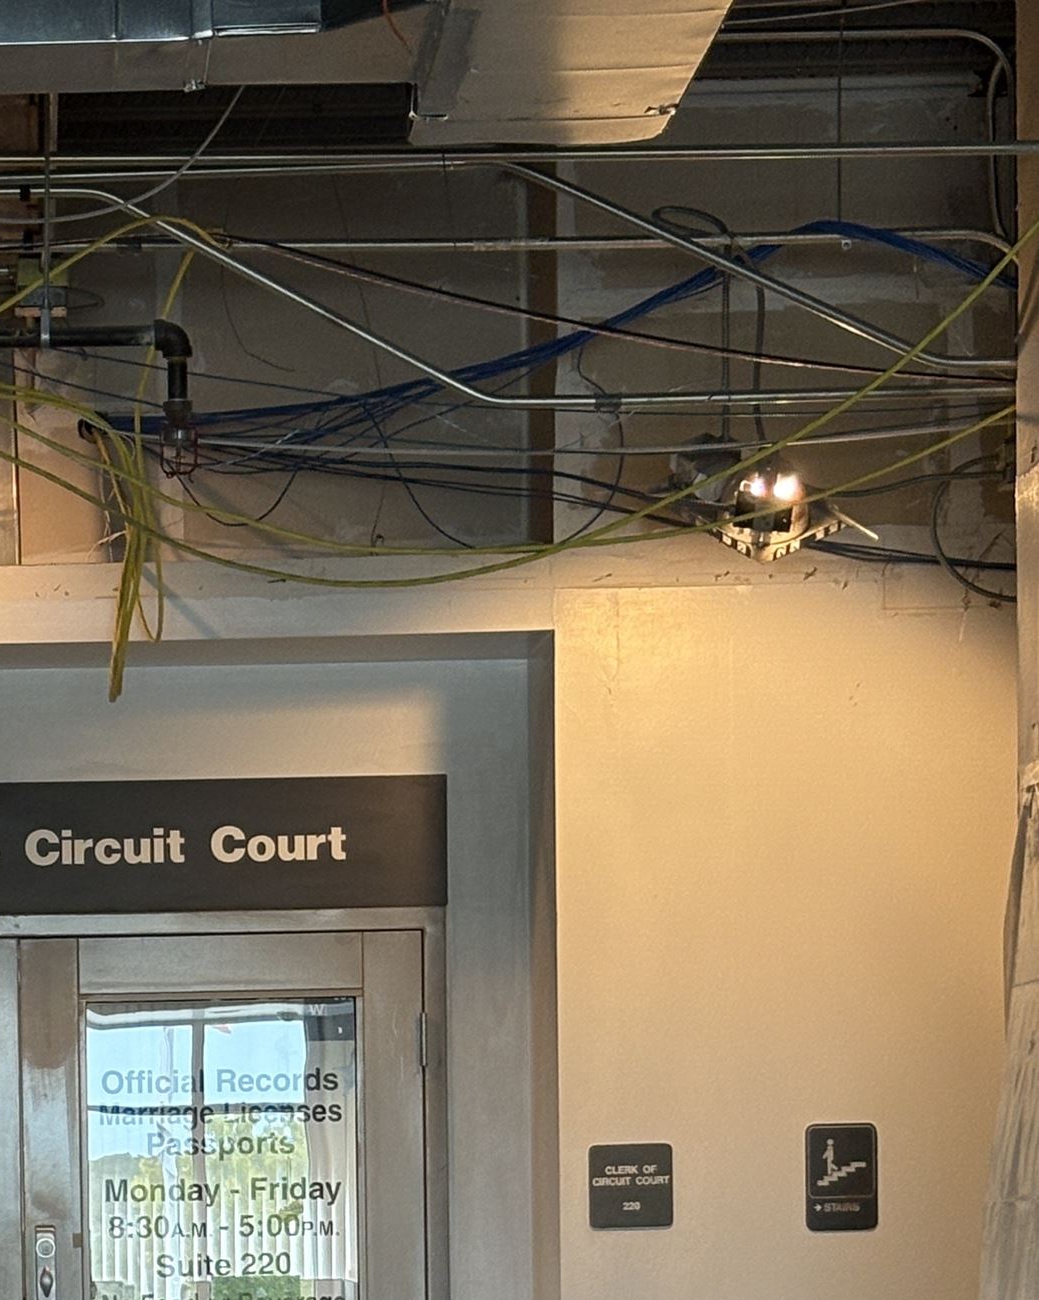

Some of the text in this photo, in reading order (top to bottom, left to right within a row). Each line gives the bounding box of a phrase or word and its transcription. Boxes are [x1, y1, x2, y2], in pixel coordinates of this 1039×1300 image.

[24, 827, 185, 867] Circuit
[211, 825, 347, 863] Court
[101, 1067, 339, 1095] Official Records
[99, 1102, 342, 1131] Marriage Licenses
[147, 1132, 295, 1161] Passports
[592, 1175, 670, 1187] CIRCUIT COURT
[605, 1164, 658, 1175] CLERK OF
[105, 1178, 220, 1207] Monday
[251, 1176, 342, 1206] Friday
[622, 1201, 641, 1211] 220
[157, 1252, 291, 1277] Suite 220
